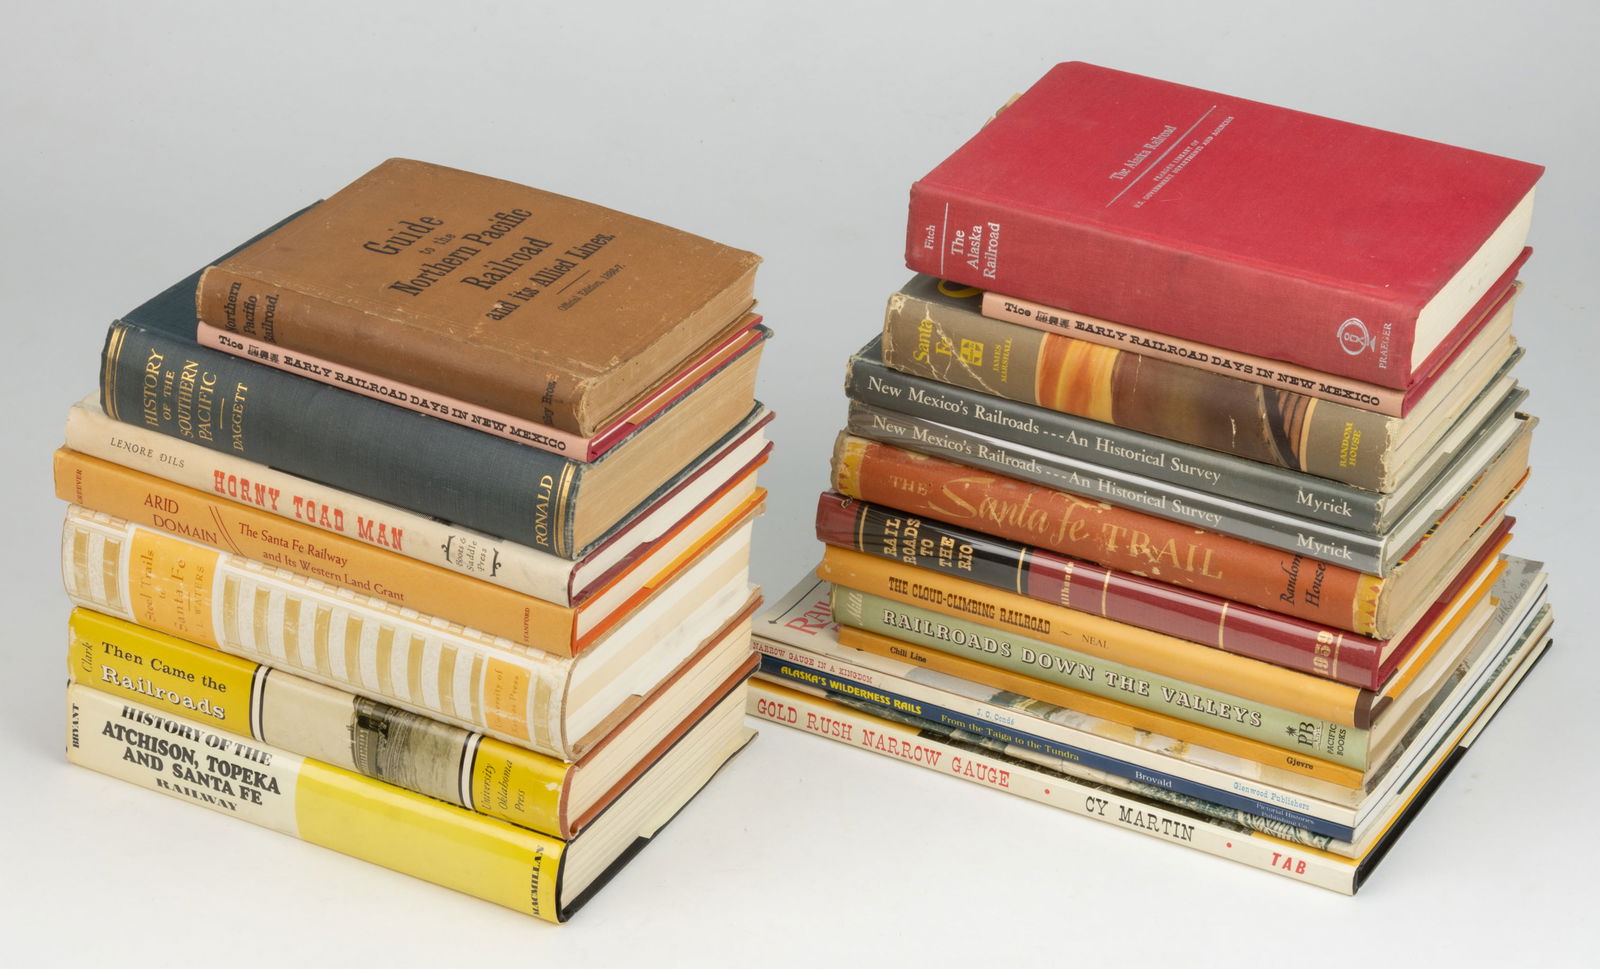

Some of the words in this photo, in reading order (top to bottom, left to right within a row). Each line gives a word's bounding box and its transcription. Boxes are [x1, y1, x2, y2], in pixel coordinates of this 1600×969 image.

[1109, 168, 1130, 180] The
[1124, 150, 1152, 169] Alaska
[1143, 124, 1177, 150] Railroad
[363, 215, 444, 256] Guide
[388, 244, 482, 297] Northern
[461, 208, 533, 256] Pacific
[419, 247, 436, 256] to
[433, 233, 456, 246] the
[924, 225, 936, 249] Fitch
[951, 230, 965, 255] The
[967, 225, 983, 270] Alaska
[983, 222, 1001, 280] Railroad
[460, 236, 553, 291] Railroad
[485, 299, 521, 321] and
[507, 285, 541, 302] its
[529, 257, 579, 289] Allied
[243, 295, 259, 336] Pacific
[912, 319, 932, 363] Santa
[1004, 302, 1032, 317] Tice
[1074, 320, 1127, 341] EARLY
[1129, 336, 1209, 363] RAILROAD
[1211, 356, 1254, 375] DAYS
[1257, 367, 1275, 381] IN
[1277, 374, 1317, 392] NEW
[1319, 383, 1381, 406] MEXICO
[1378, 322, 1393, 369] PRAEGER
[144, 348, 164, 427] HISTORY
[164, 370, 175, 397] THE
[178, 360, 199, 438] SOUTHERN
[219, 335, 244, 350] Tice
[284, 356, 331, 376] EARLY
[335, 372, 407, 402] RAILROAD
[410, 395, 448, 414] DAYS
[452, 407, 468, 420] IN
[471, 414, 507, 432] NEW
[510, 426, 566, 451] MEXICO
[163, 403, 173, 421] OF
[198, 372, 217, 441] PACIFIC
[232, 382, 249, 451] DAGGETT
[868, 375, 902, 399] New
[908, 387, 969, 418] Mexico's
[1096, 437, 1164, 468] Historical
[1170, 458, 1221, 486] Survey
[1340, 423, 1353, 467] RANDOM
[1349, 430, 1361, 467] HOUSE
[111, 438, 153, 458] LENORE
[160, 455, 185, 469] DILS
[872, 415, 906, 435] New
[911, 426, 971, 455] Mexico's
[1098, 478, 1165, 510] Historical
[1172, 498, 1222, 528] Survey
[144, 494, 179, 515] ARID
[214, 470, 280, 511] HORNY
[293, 496, 344, 532] TOAD
[358, 517, 403, 551] MAN
[535, 474, 553, 547] RONALD
[1296, 490, 1352, 517] Myrick
[153, 515, 217, 545] DOMAIN
[238, 523, 258, 541] The
[261, 530, 289, 549] Santa
[292, 540, 304, 553] Fe
[307, 545, 348, 568] Railway
[884, 518, 901, 557] RAIL
[889, 475, 929, 495] THE
[928, 477, 1050, 532] Santa
[1050, 501, 1111, 546] Fe
[1102, 523, 1223, 581] TRAIL
[902, 518, 921, 566] ROADS
[921, 539, 935, 556] TO
[1296, 533, 1353, 561] Myrick
[141, 550, 156, 590] Trails
[477, 549, 487, 572] Press
[939, 535, 955, 567] THE
[958, 544, 973, 571] RIO
[263, 552, 282, 564] and
[284, 555, 297, 568] Its
[300, 560, 342, 583] Western
[344, 573, 371, 592] Land
[374, 583, 404, 602] Grant
[1280, 555, 1303, 607] Random
[1305, 563, 1327, 609] House
[888, 576, 909, 596] THE
[911, 583, 995, 620] CLOUD-CLIMBING
[999, 607, 1051, 636] RAILROAD
[1081, 633, 1109, 650] NEAL
[82, 642, 93, 673] Clark
[102, 641, 143, 668] Then
[150, 657, 195, 685] Came
[202, 675, 226, 693] the
[752, 641, 785, 657] NARROW
[788, 652, 815, 667] GAUGE
[817, 661, 827, 670] IN
[838, 668, 873, 685] KINGDOM
[882, 608, 1011, 658] RAILROADS
[1021, 649, 1094, 682] DOWN
[1104, 671, 1150, 697] THE
[1161, 686, 1262, 728] VALLEYS
[890, 646, 909, 661] Chili
[910, 651, 928, 664] Line
[1313, 631, 1333, 675] 1959
[100, 664, 226, 720] Railroads
[780, 666, 827, 688] ALASKA'S
[829, 680, 891, 706] WILDERNESS
[893, 700, 922, 716] RAILS
[122, 705, 203, 743] HISTORY
[205, 734, 231, 752] OF
[233, 743, 272, 768] THE
[940, 714, 966, 730] From
[969, 722, 984, 734] the
[986, 728, 1013, 744] Taiga
[1014, 737, 1025, 745] to
[1026, 740, 1042, 751] the
[1044, 744, 1080, 762] Tundra
[1297, 721, 1315, 748] PB
[1326, 722, 1337, 755] PACIFIC
[1336, 728, 1347, 757] BOOKS
[101, 721, 199, 770] ATCHISON,
[206, 755, 281, 796] TOPEKA
[123, 746, 164, 773] AND
[172, 763, 235, 797] SANTA
[239, 784, 263, 806] FE
[1135, 770, 1172, 788] Brovald
[1286, 756, 1314, 770] Gjevre
[156, 778, 238, 811] RAILWAY
[481, 763, 496, 811] University
[498, 760, 513, 811] Oklahoma
[514, 789, 526, 813] Press
[756, 698, 798, 725] GOLD
[806, 713, 853, 741] RUSH
[862, 730, 942, 768] NARROW
[951, 756, 1011, 789] GAUGE
[1085, 796, 1109, 818] CY
[1118, 805, 1196, 843] MARTIN
[1271, 852, 1308, 876] TAB
[531, 845, 544, 916] MACMILLAN
